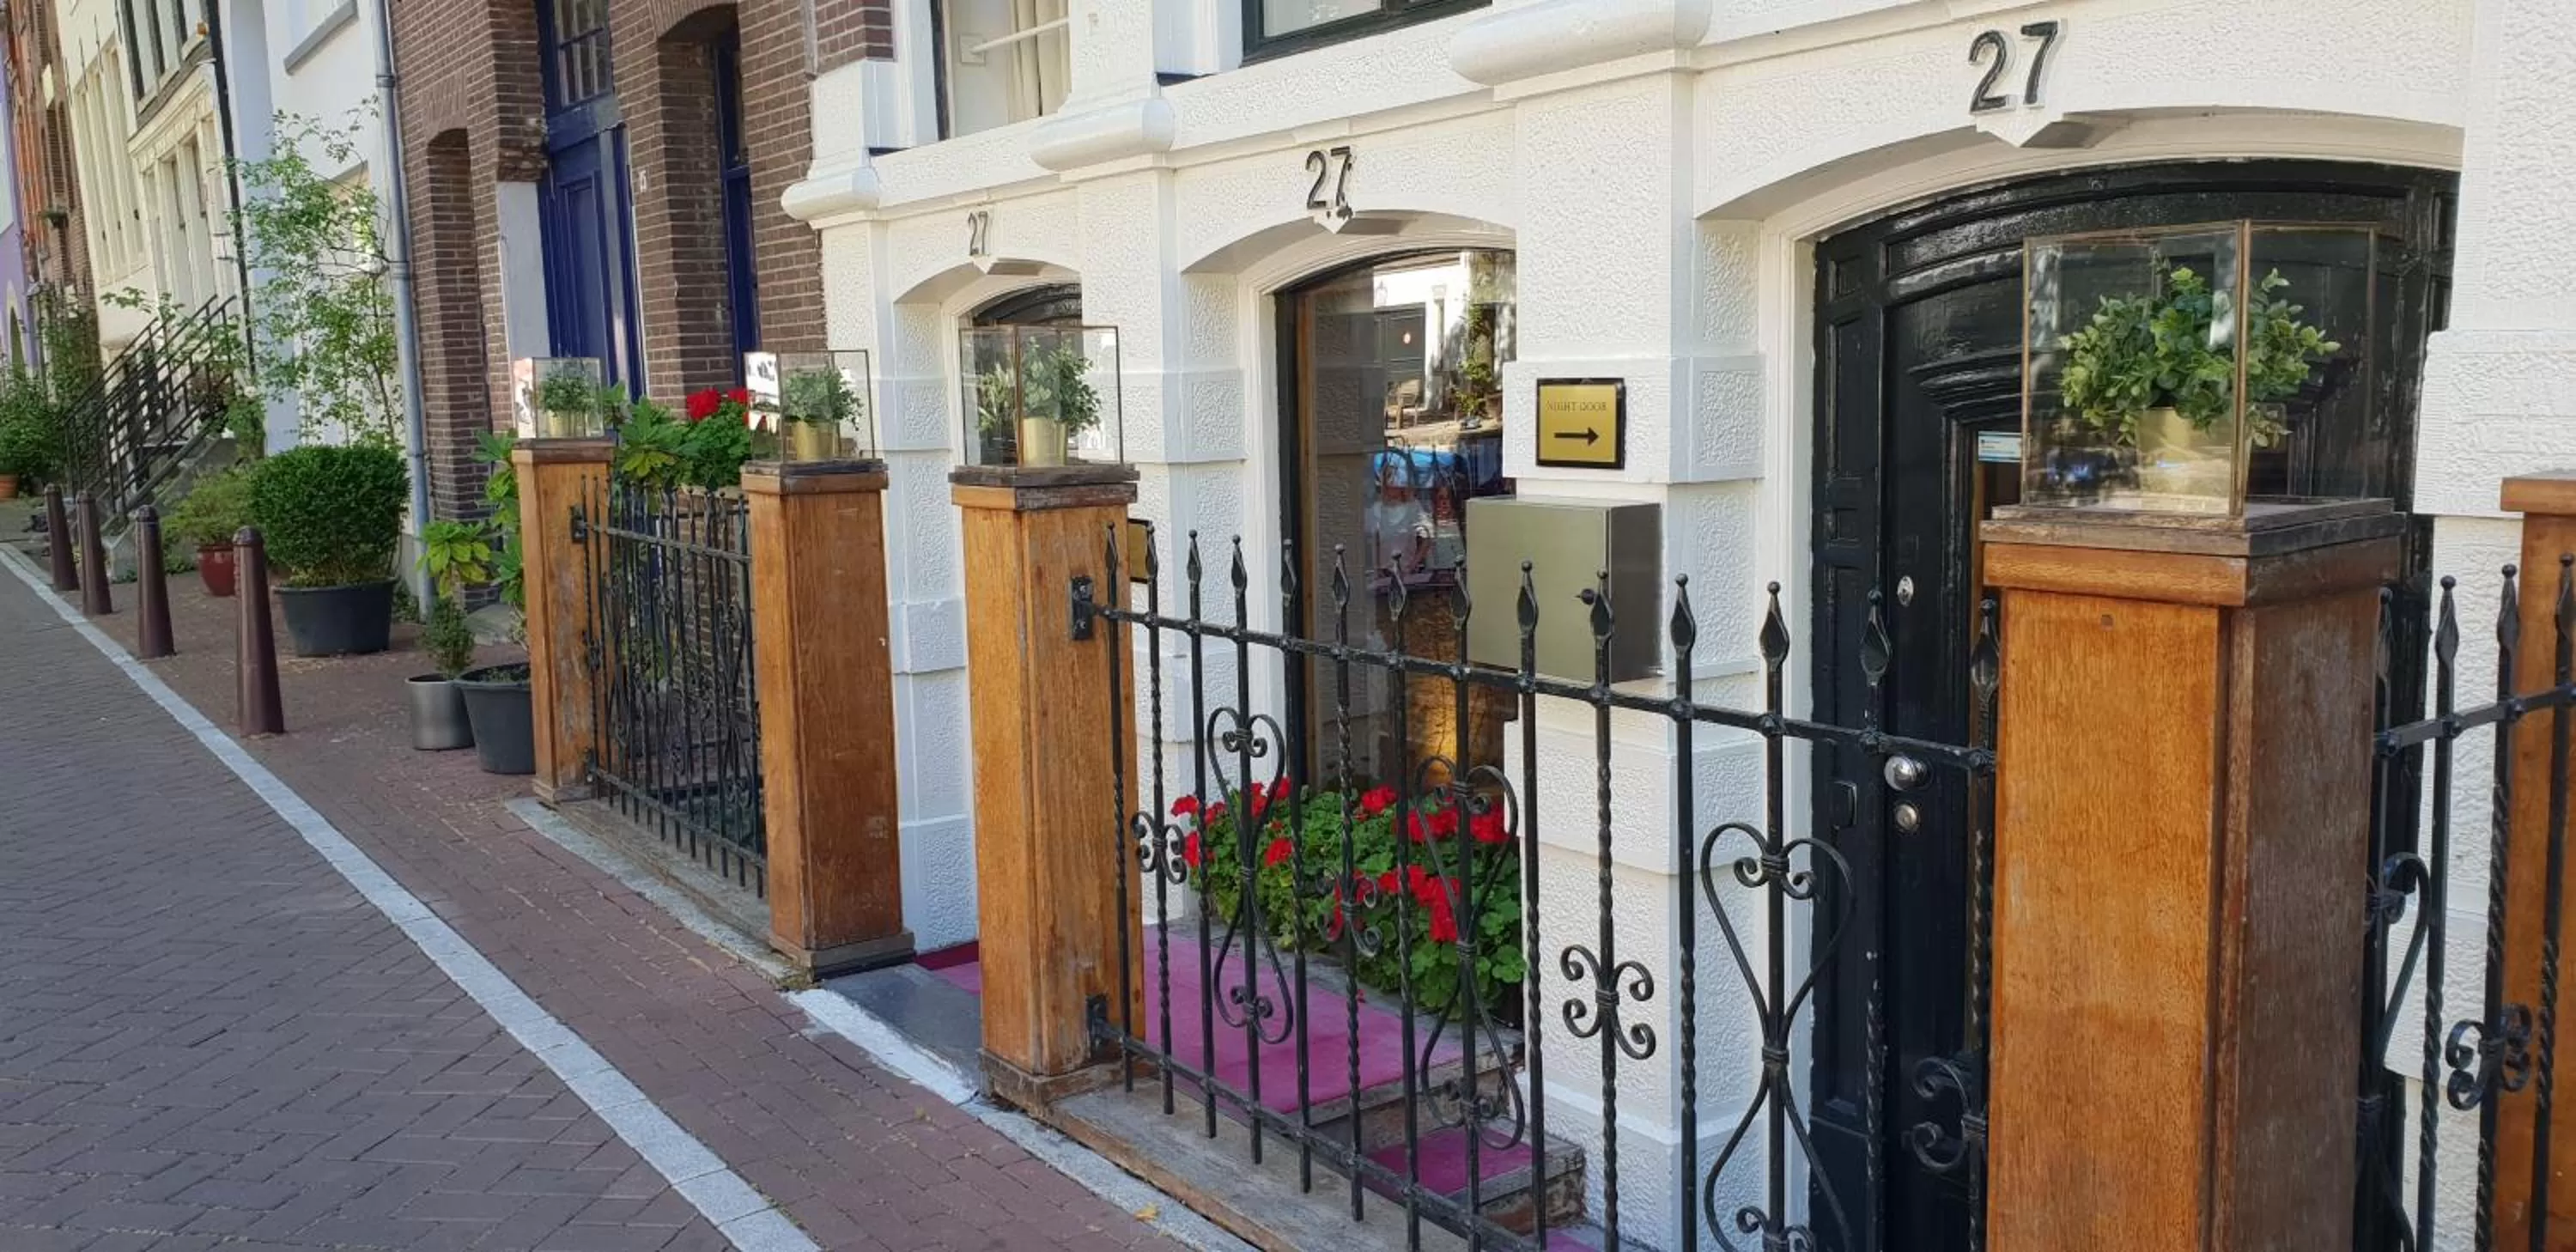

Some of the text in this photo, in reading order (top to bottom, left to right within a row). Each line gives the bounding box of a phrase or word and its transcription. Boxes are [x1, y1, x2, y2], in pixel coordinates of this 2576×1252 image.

[1968, 21, 2058, 112] 27
[1305, 146, 1352, 209] 27
[968, 210, 988, 256] 27
[1546, 400, 1578, 412] NIGHT
